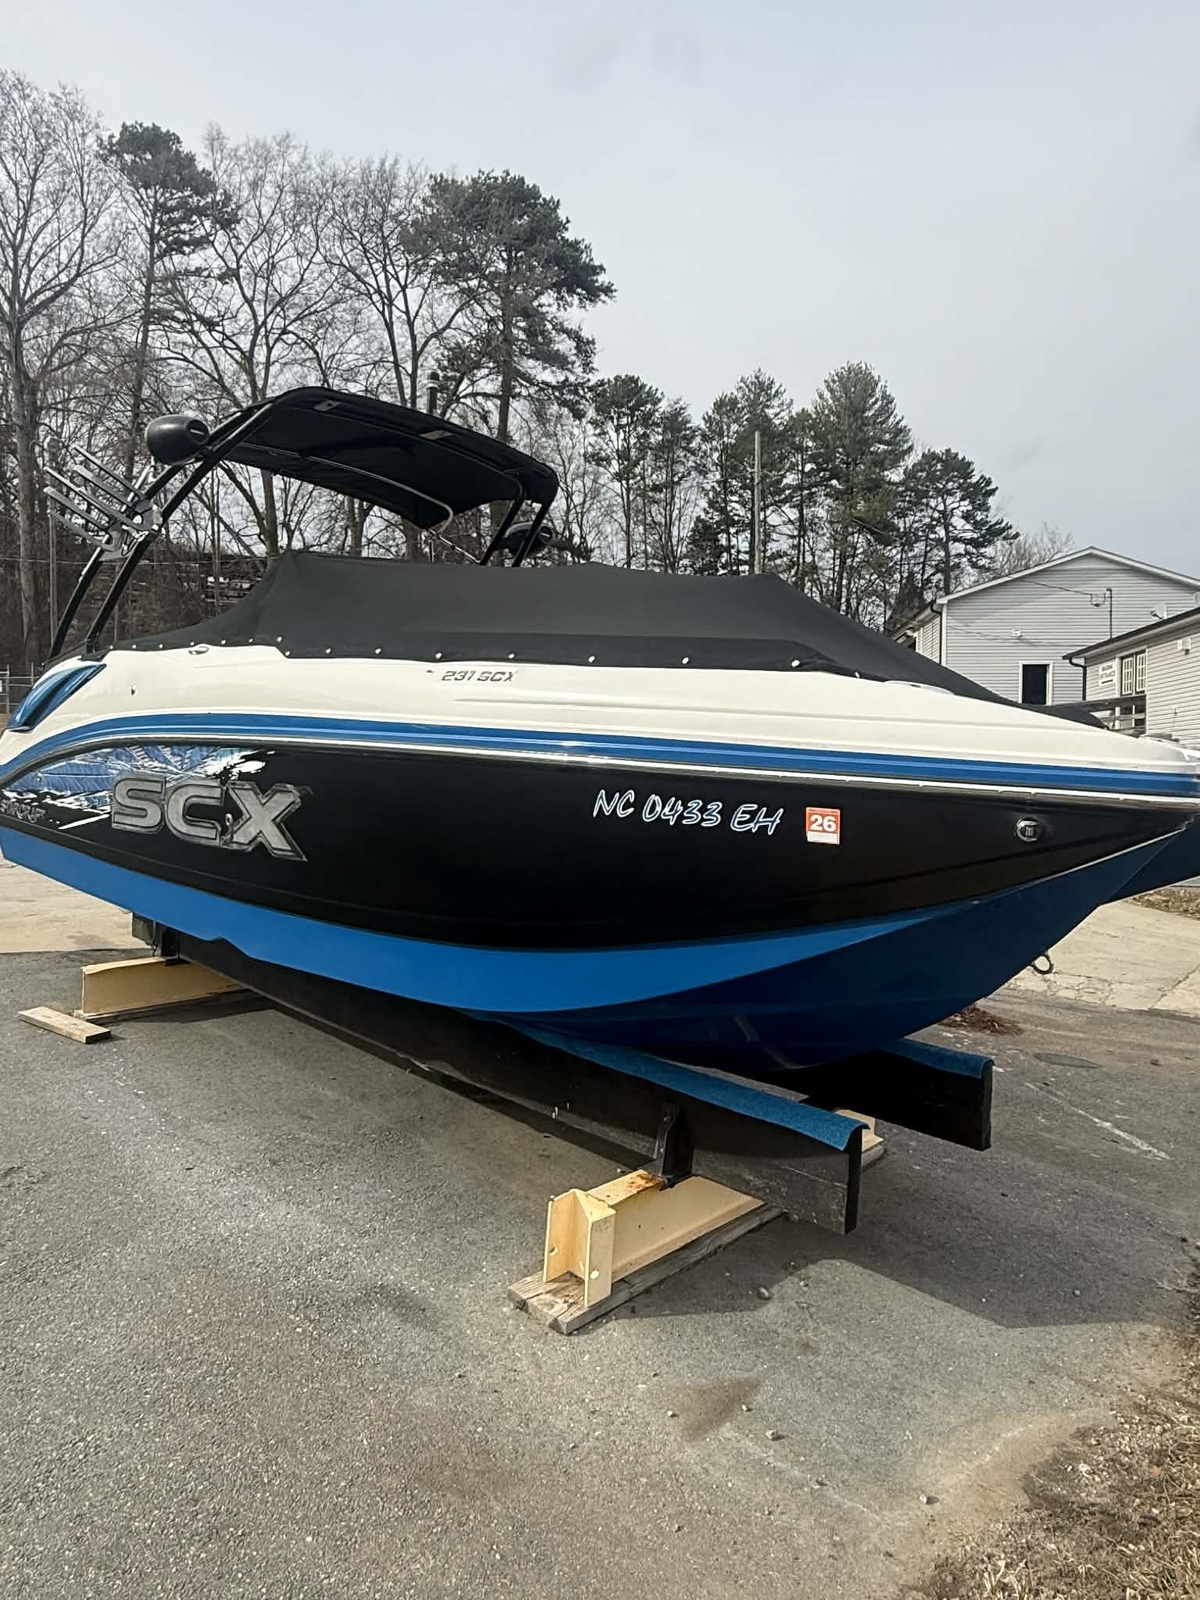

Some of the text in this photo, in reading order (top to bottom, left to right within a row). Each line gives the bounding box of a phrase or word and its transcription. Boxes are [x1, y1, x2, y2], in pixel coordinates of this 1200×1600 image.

[441, 669, 519, 682] 231 SCX
[111, 771, 308, 862] SCX
[593, 789, 784, 835] NC 0433 EH
[809, 814, 837, 832] 26
